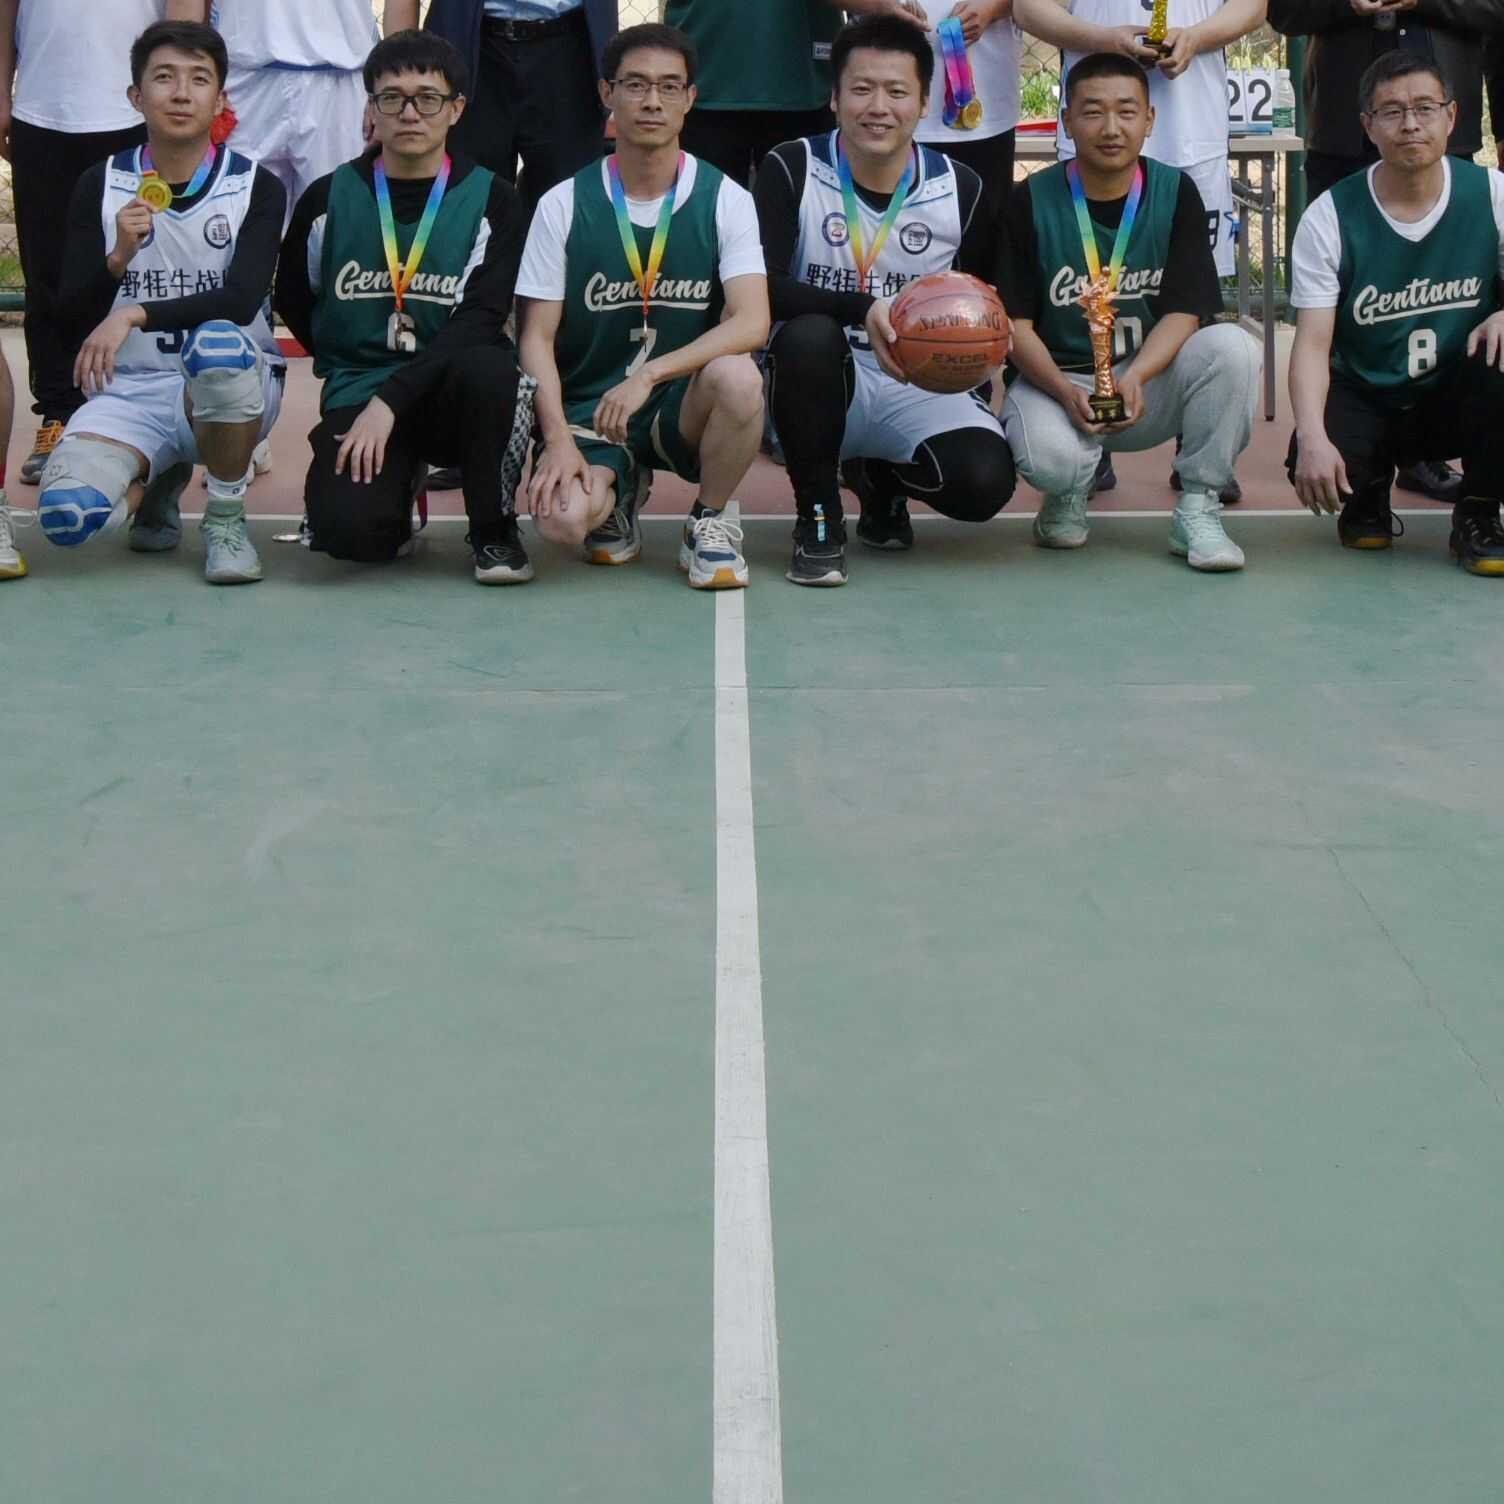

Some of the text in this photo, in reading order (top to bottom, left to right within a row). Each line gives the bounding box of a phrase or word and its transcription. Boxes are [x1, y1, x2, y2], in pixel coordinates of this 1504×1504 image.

[121, 268, 228, 298] 野牦牛战
[335, 260, 458, 305] Genana
[584, 272, 711, 311] Geniana
[806, 263, 921, 297] 野牦牛战
[1353, 277, 1482, 325] Gentiana
[625, 327, 657, 377] 7
[1407, 328, 1438, 379] 8
